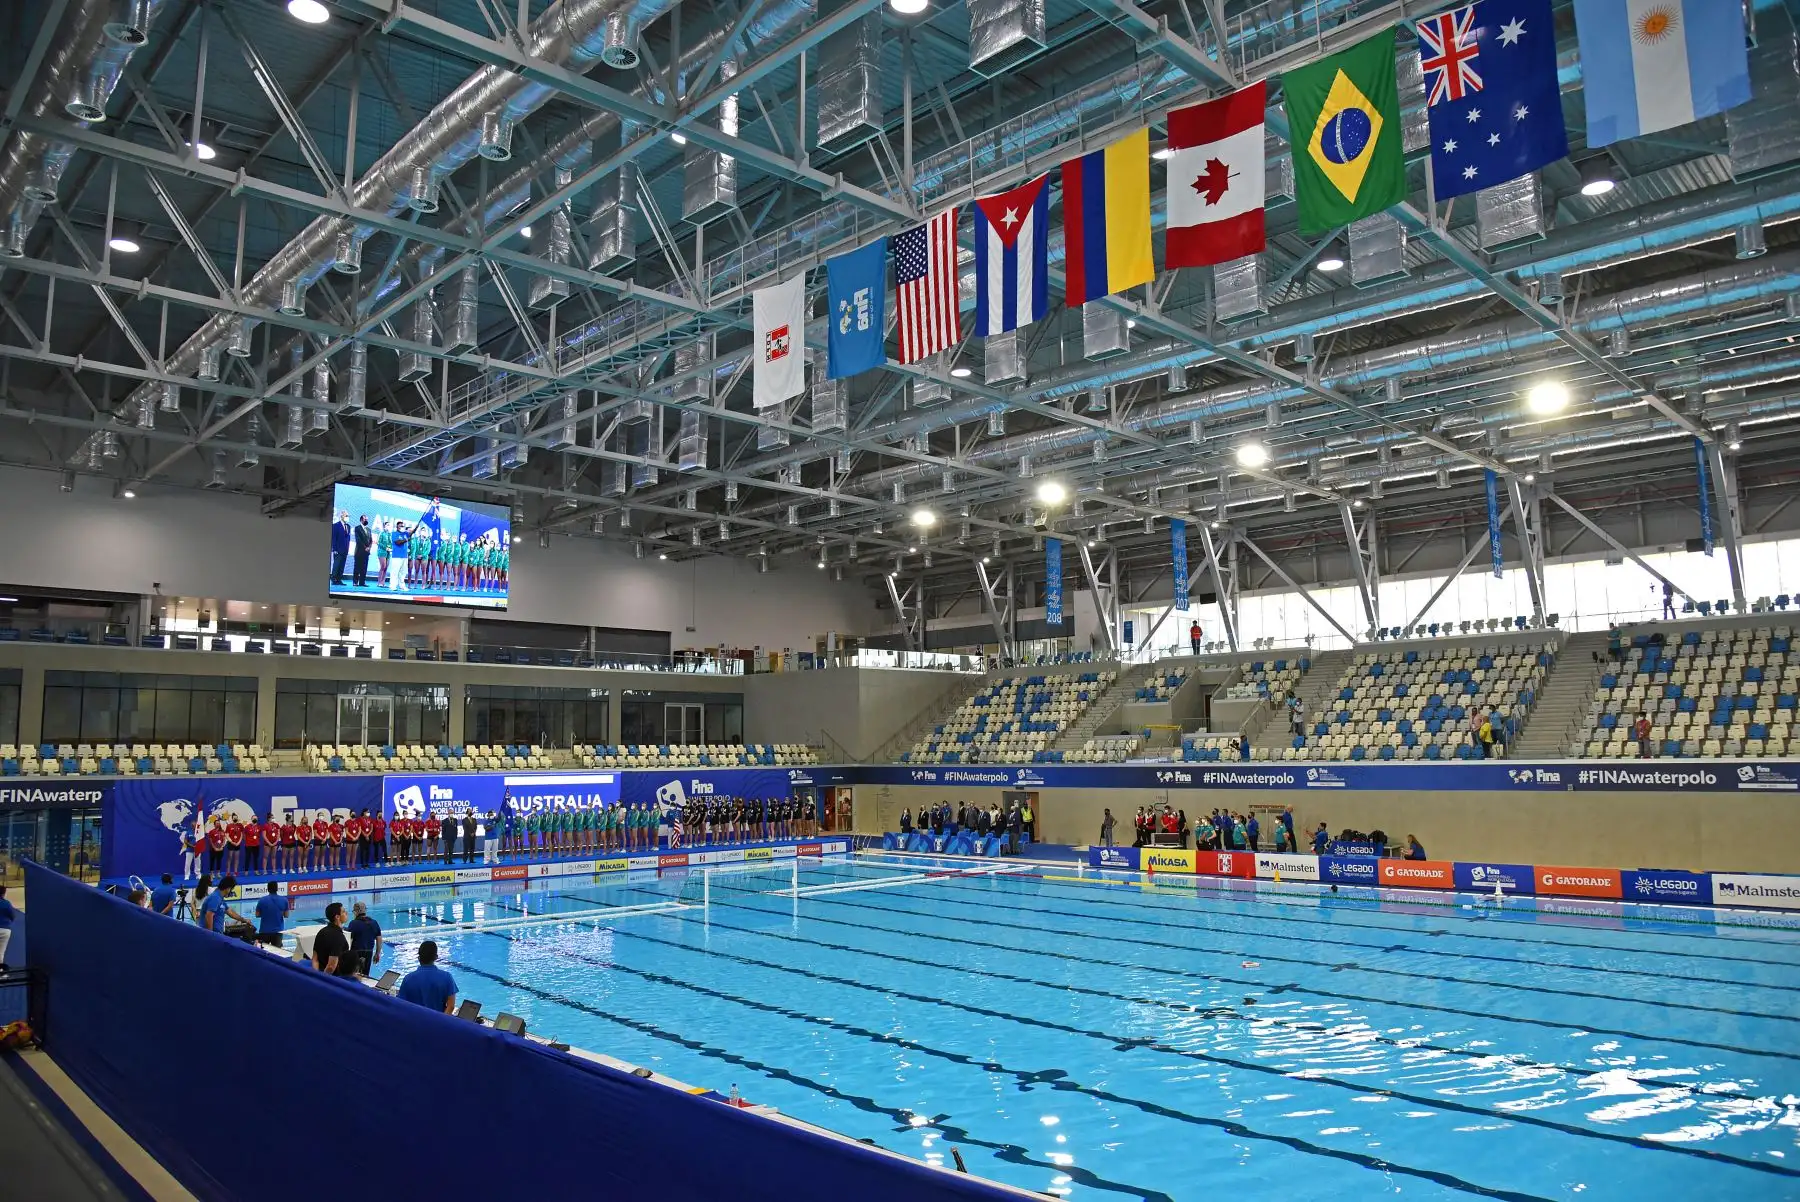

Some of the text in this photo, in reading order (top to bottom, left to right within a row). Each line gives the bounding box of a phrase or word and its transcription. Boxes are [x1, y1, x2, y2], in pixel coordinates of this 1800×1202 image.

[1047, 612, 1062, 623] 208
[944, 772, 1009, 783] #FINAwaterpolo
[1203, 772, 1294, 786] #FINAwaterpolo
[1579, 770, 1717, 787] #FINAwaterpolo
[510, 794, 603, 811] AUSTRALIA
[1271, 862, 1315, 873] Malmsten
[1397, 868, 1444, 878] GATORADE
[1556, 876, 1611, 887] GATORADE
